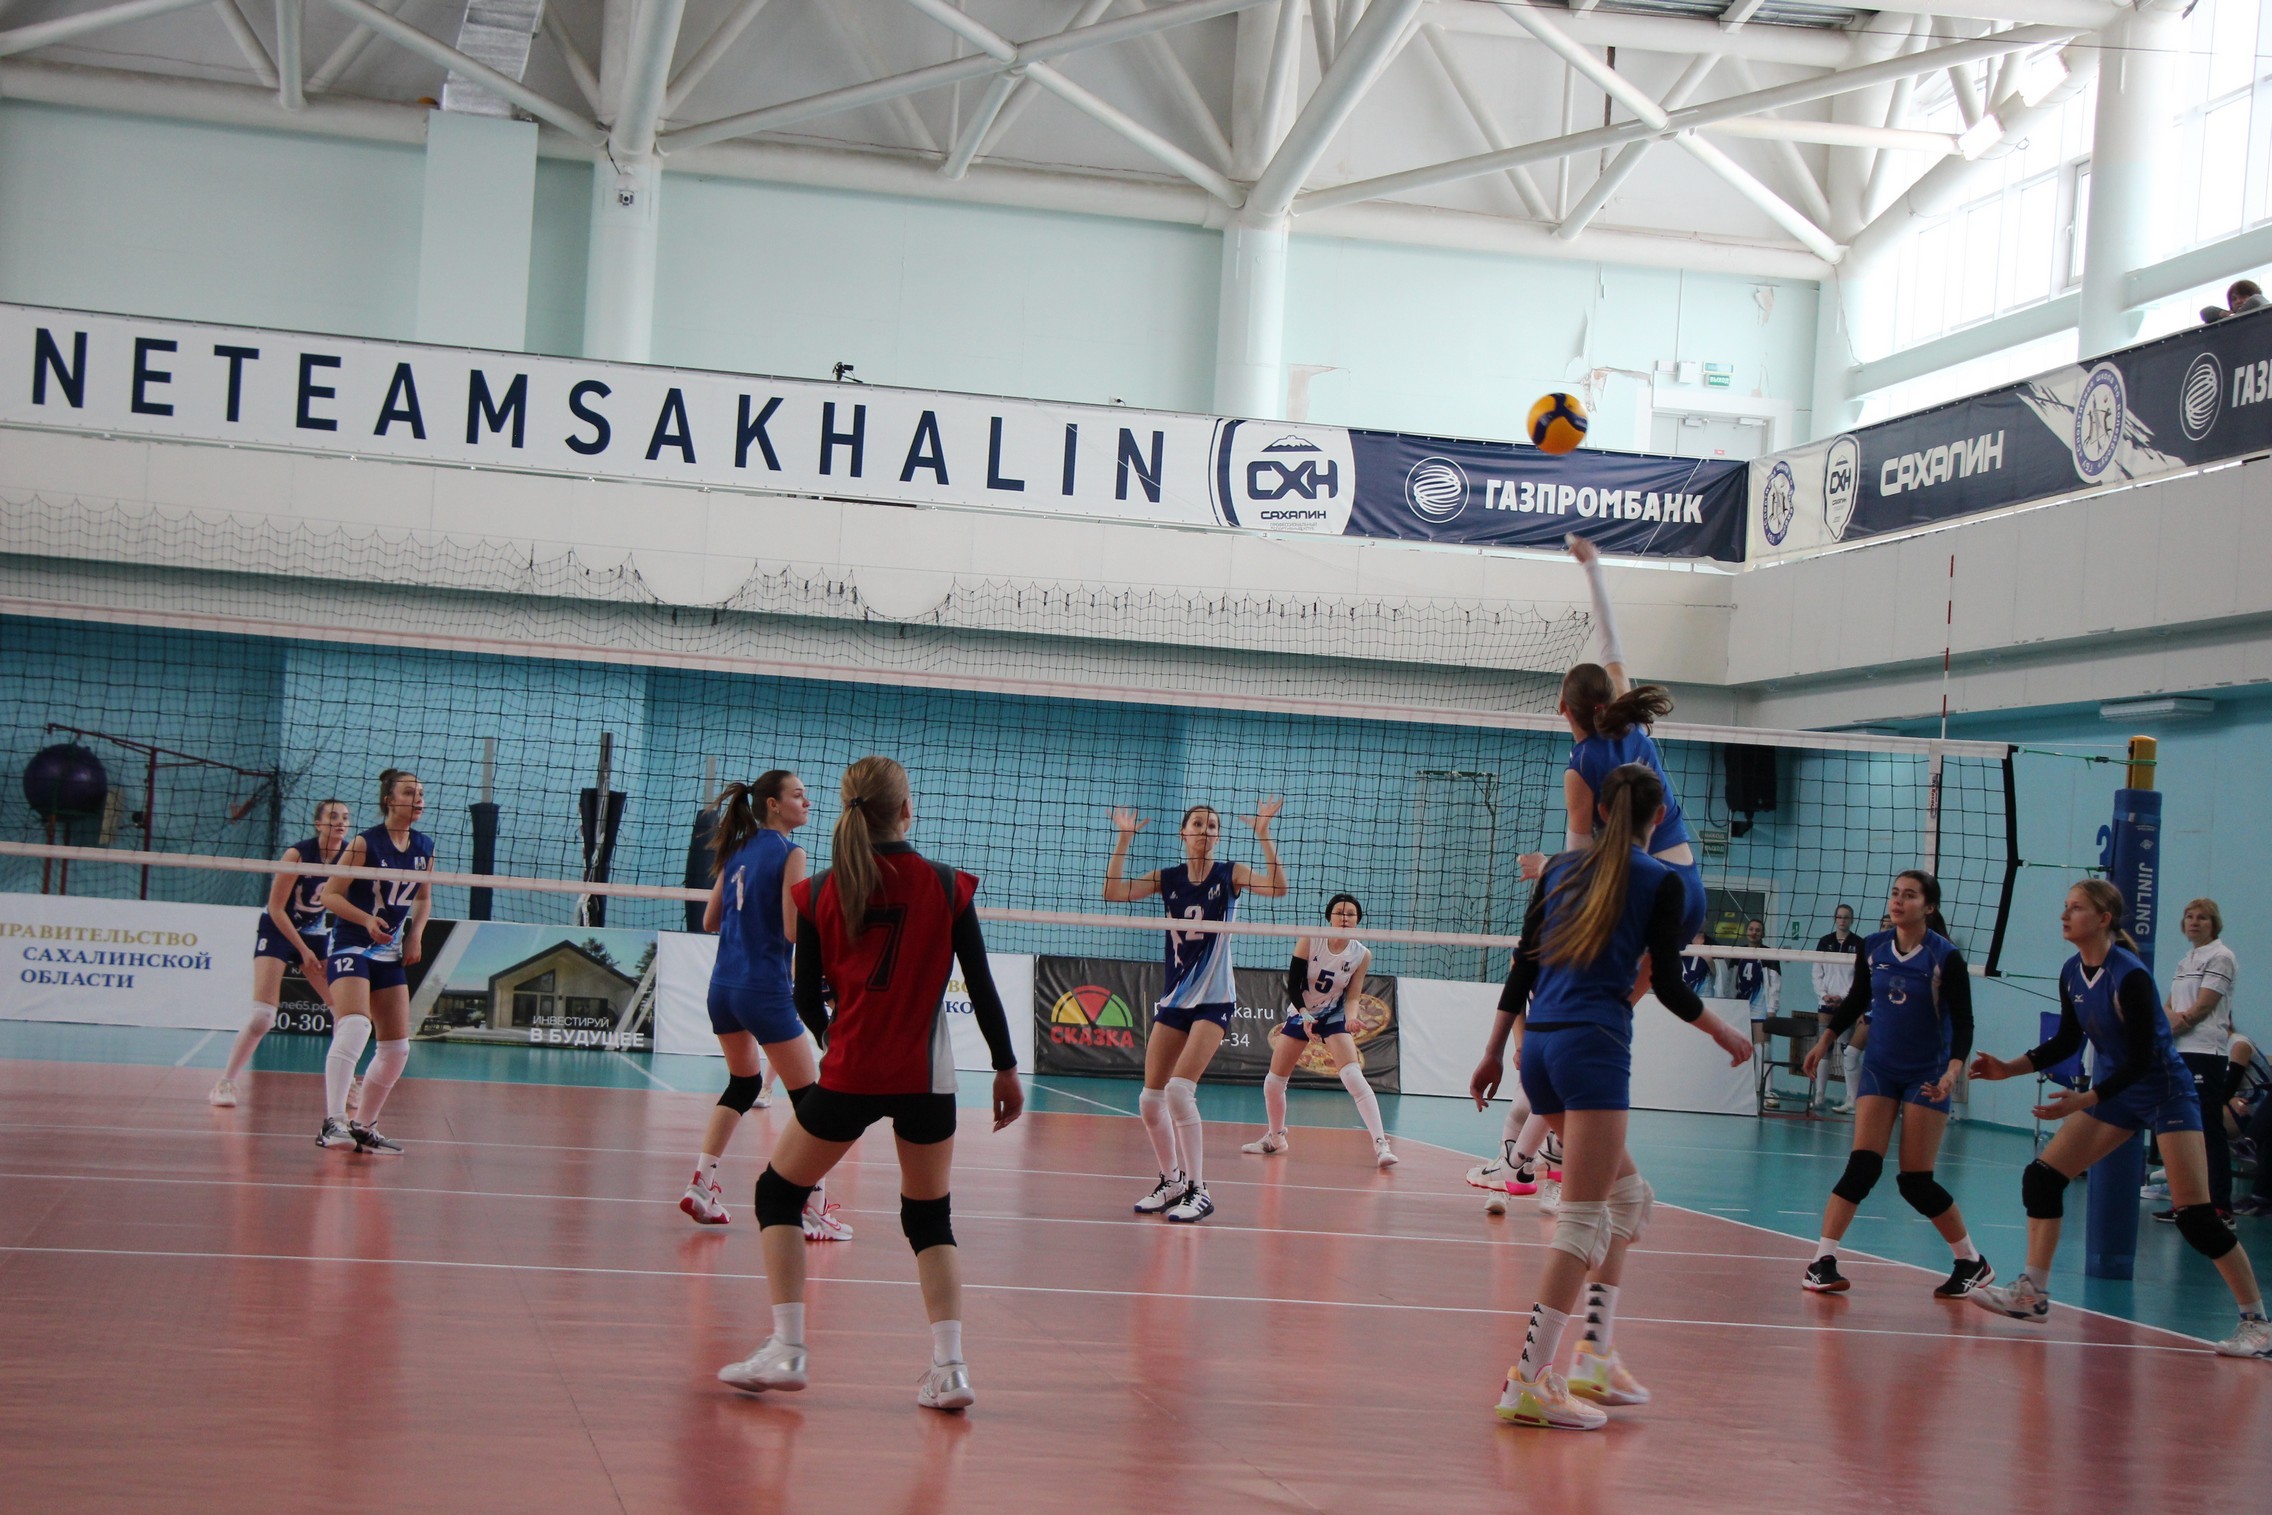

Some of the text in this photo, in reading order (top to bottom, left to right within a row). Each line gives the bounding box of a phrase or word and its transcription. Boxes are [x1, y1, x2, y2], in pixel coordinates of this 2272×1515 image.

[1880, 430, 2004, 496] САХАЛИН
[1485, 479, 1704, 524] ГАЗПРОМБАНК
[1260, 510, 1326, 519] САХАЛИН
[387, 880, 418, 906] 12
[731, 865, 746, 911] 1
[2135, 862, 2153, 936] JINLING
[1183, 905, 1204, 941] 2
[23, 946, 212, 970] САХАЛИНСКОЙ
[862, 904, 907, 991] 7
[334, 957, 354, 973] 12
[1743, 963, 1753, 980] 4
[21, 969, 135, 988] ОБЛАСТИ
[1315, 969, 1335, 993] 5
[533, 1015, 609, 1028] ИНВЕСТИРУЙ
[530, 1027, 645, 1048] В БУДУЩЕЕ
[1050, 1026, 1135, 1048] СКАЗКА
